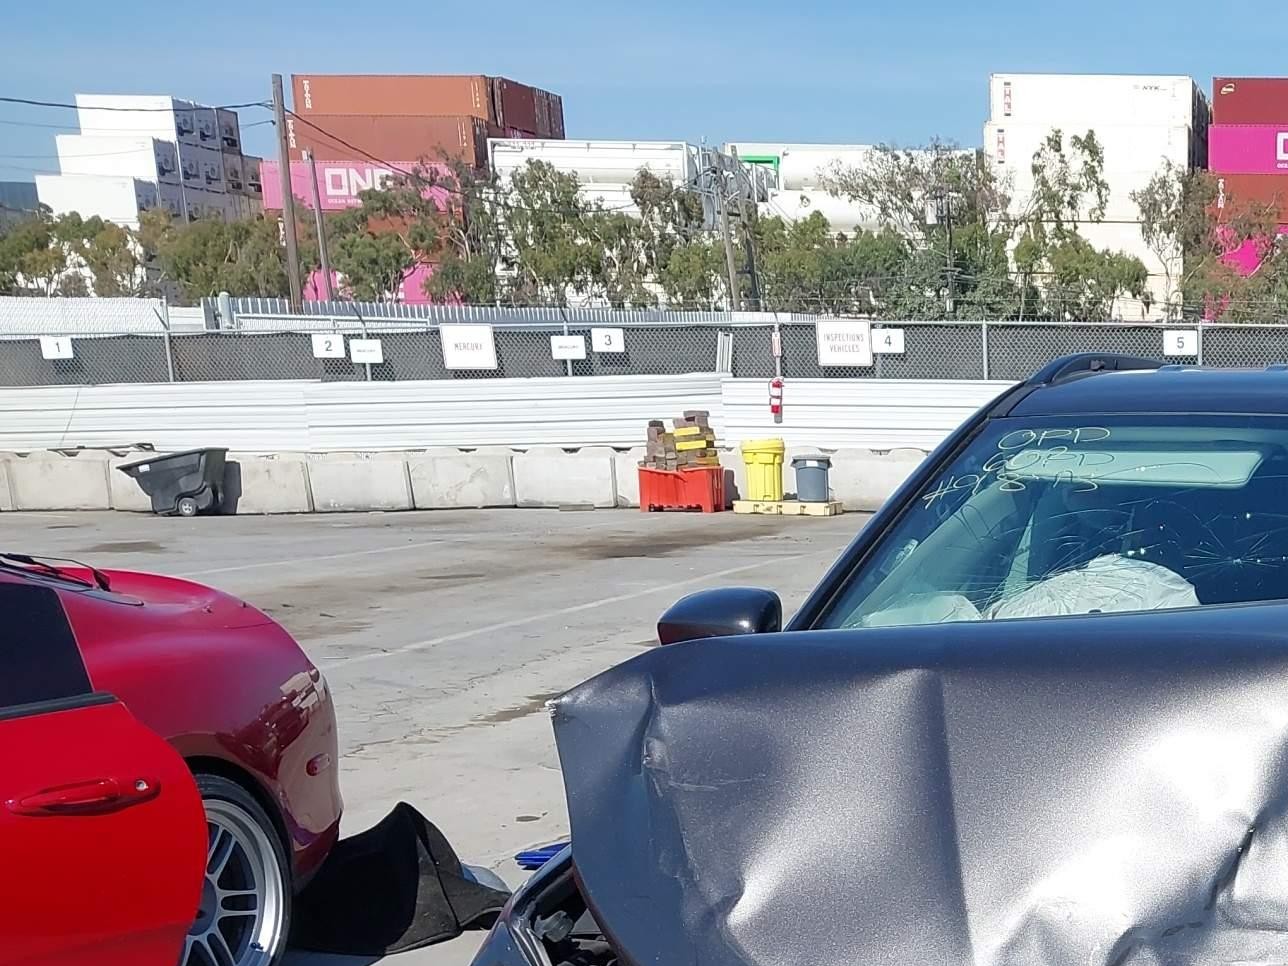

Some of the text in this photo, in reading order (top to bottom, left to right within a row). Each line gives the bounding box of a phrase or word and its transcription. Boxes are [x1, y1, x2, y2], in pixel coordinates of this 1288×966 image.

[604, 334, 612, 346] 3
[823, 333, 864, 342] INSPECTIONS
[883, 335, 892, 347] 4
[1176, 336, 1185, 349] 5
[55, 341, 61, 353] 1
[324, 340, 333, 352] 2
[829, 344, 860, 353] VEHICLES
